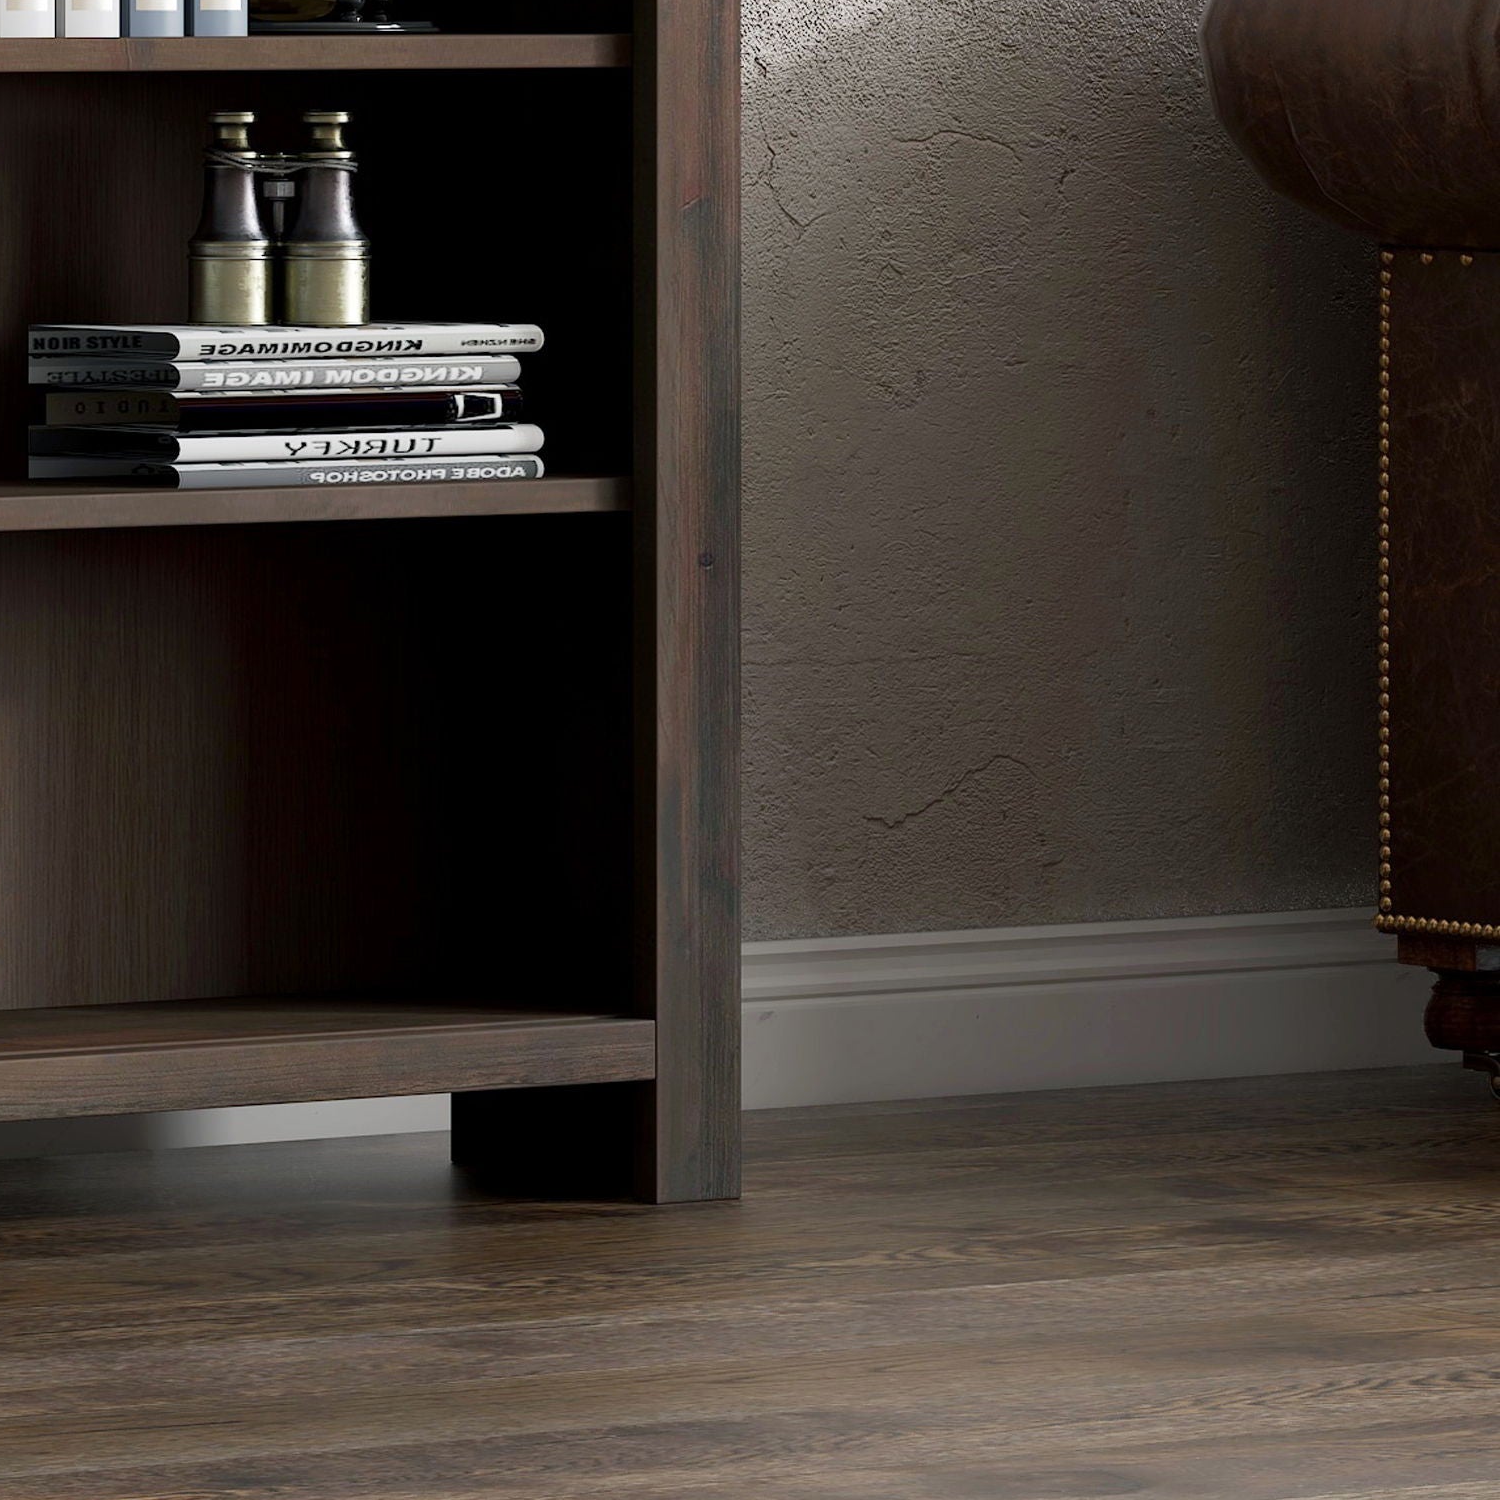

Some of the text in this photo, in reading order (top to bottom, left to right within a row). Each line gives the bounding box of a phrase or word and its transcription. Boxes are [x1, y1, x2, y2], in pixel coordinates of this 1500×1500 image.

[33, 336, 142, 350] NOIR STYLE
[47, 368, 174, 383] IFESTYLE
